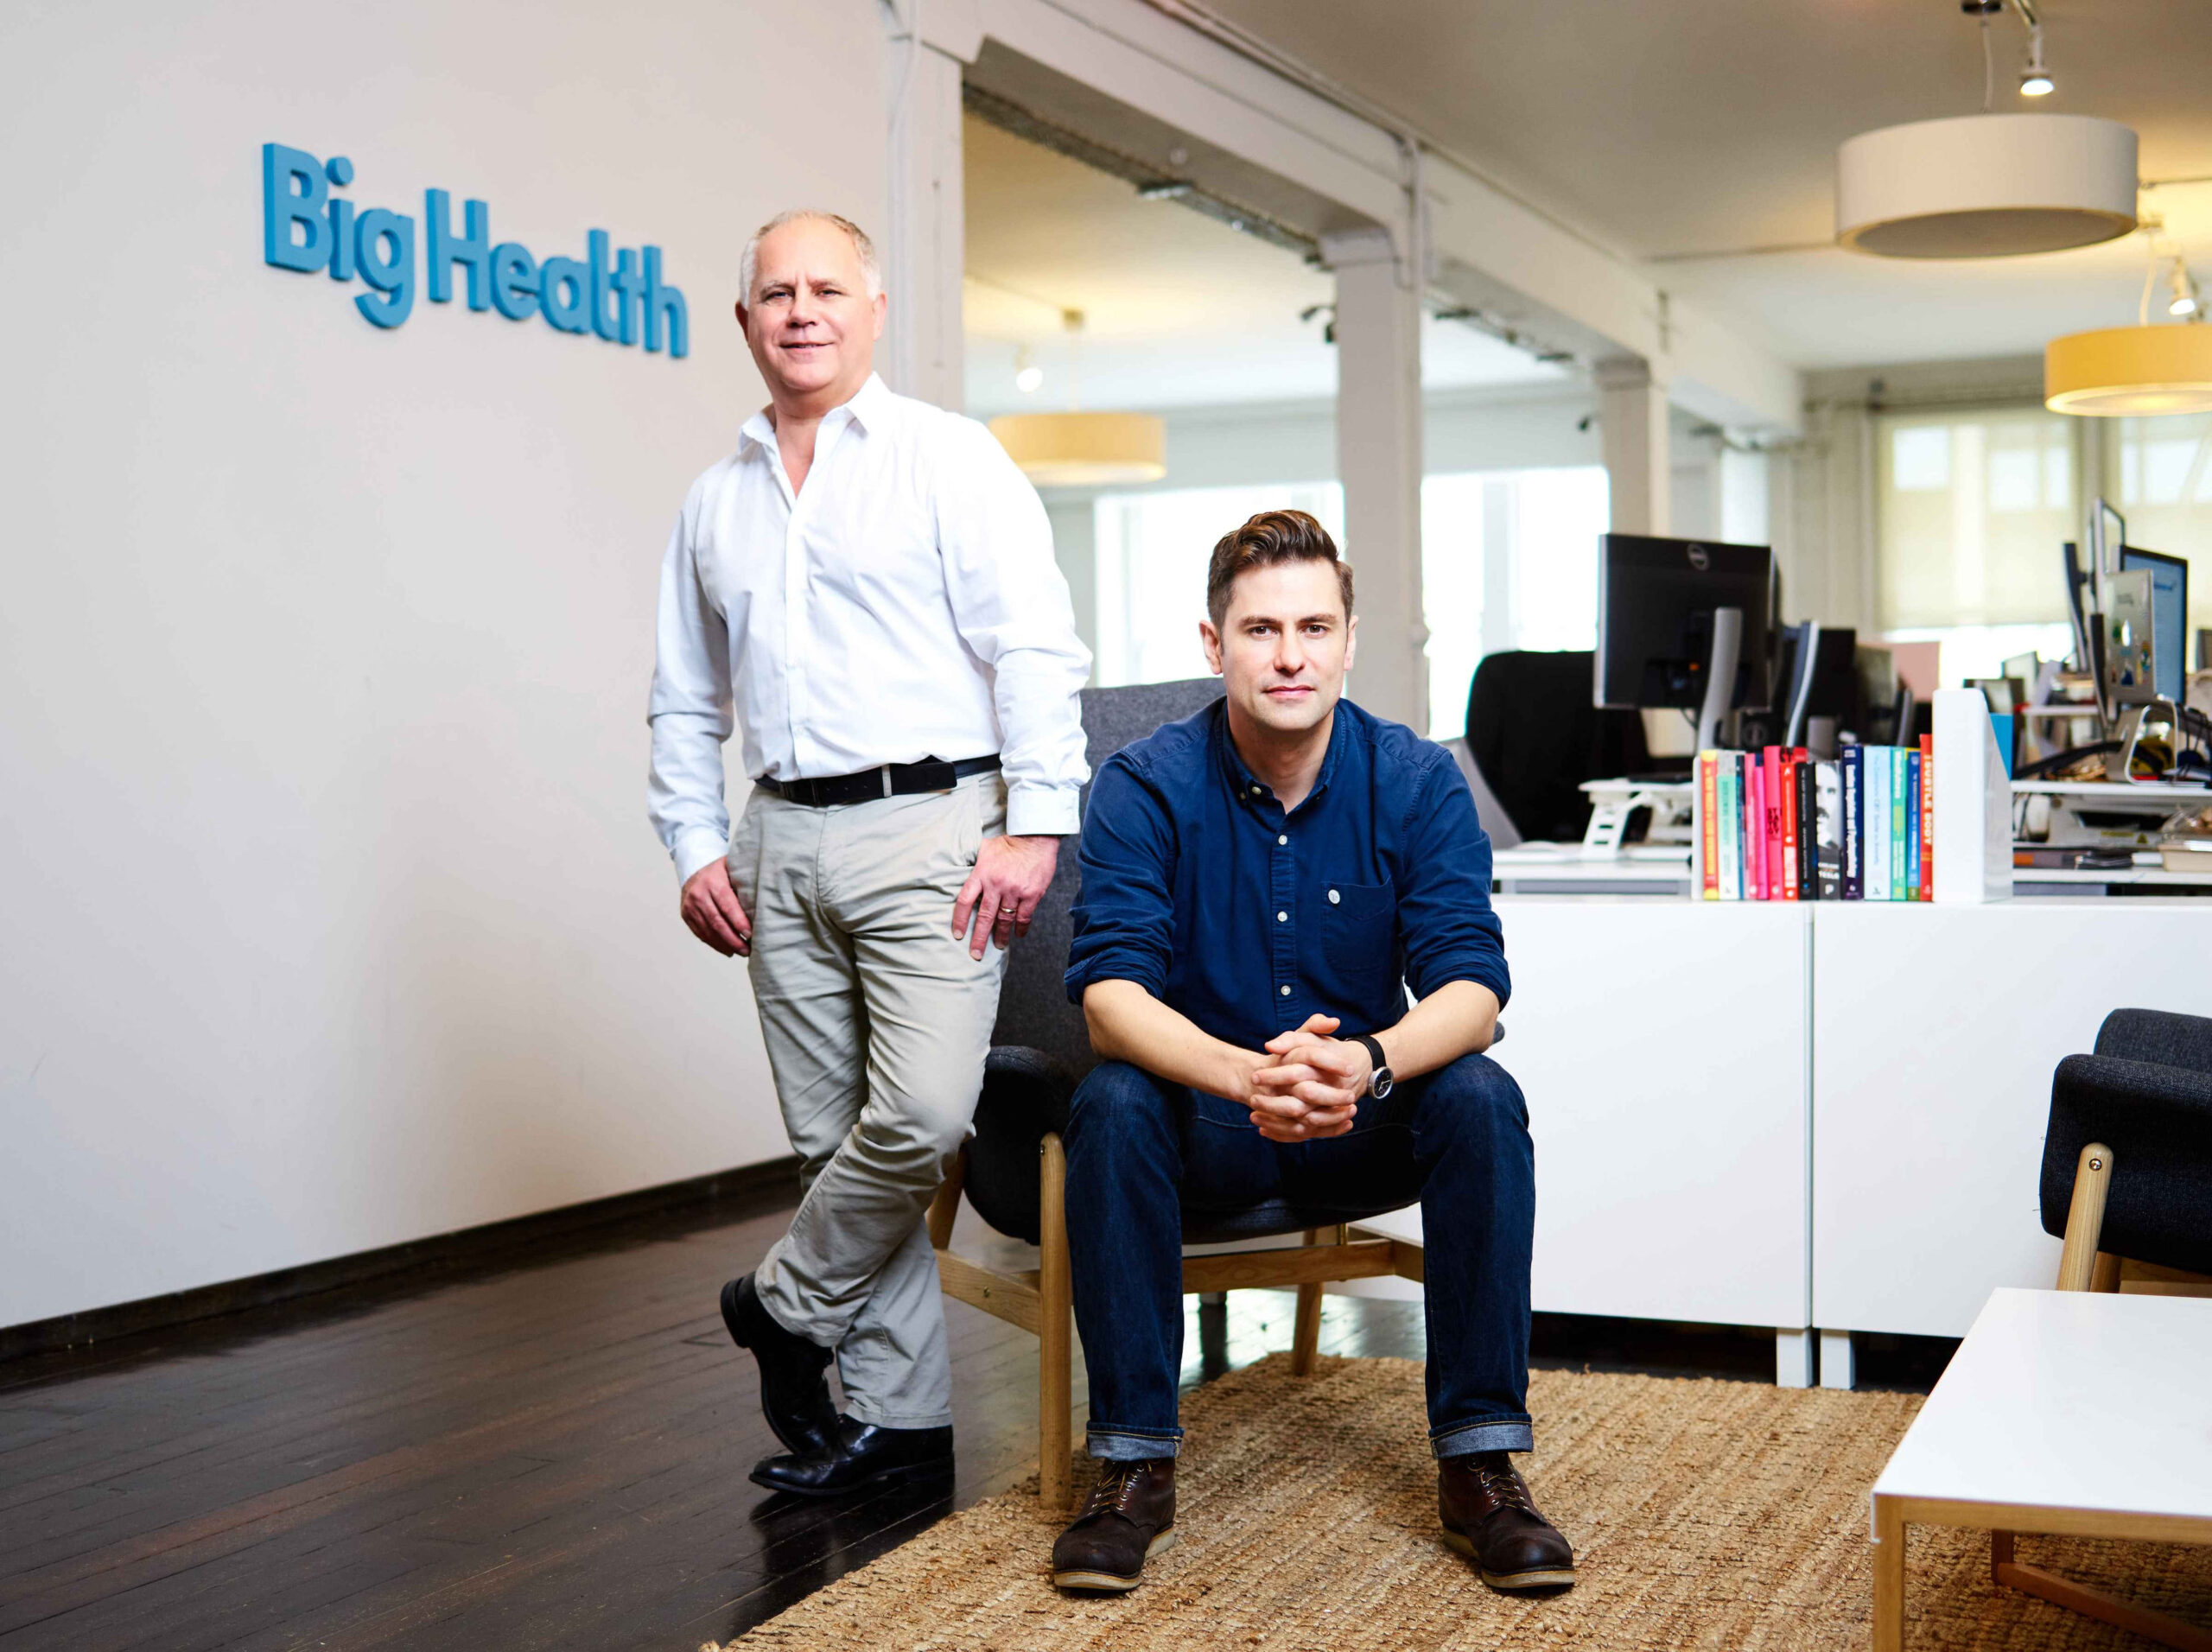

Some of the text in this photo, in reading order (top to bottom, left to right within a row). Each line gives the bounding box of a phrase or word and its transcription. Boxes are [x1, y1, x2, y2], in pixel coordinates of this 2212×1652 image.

[263, 143, 689, 359] Big Health
[1924, 812, 1933, 846] BODY
